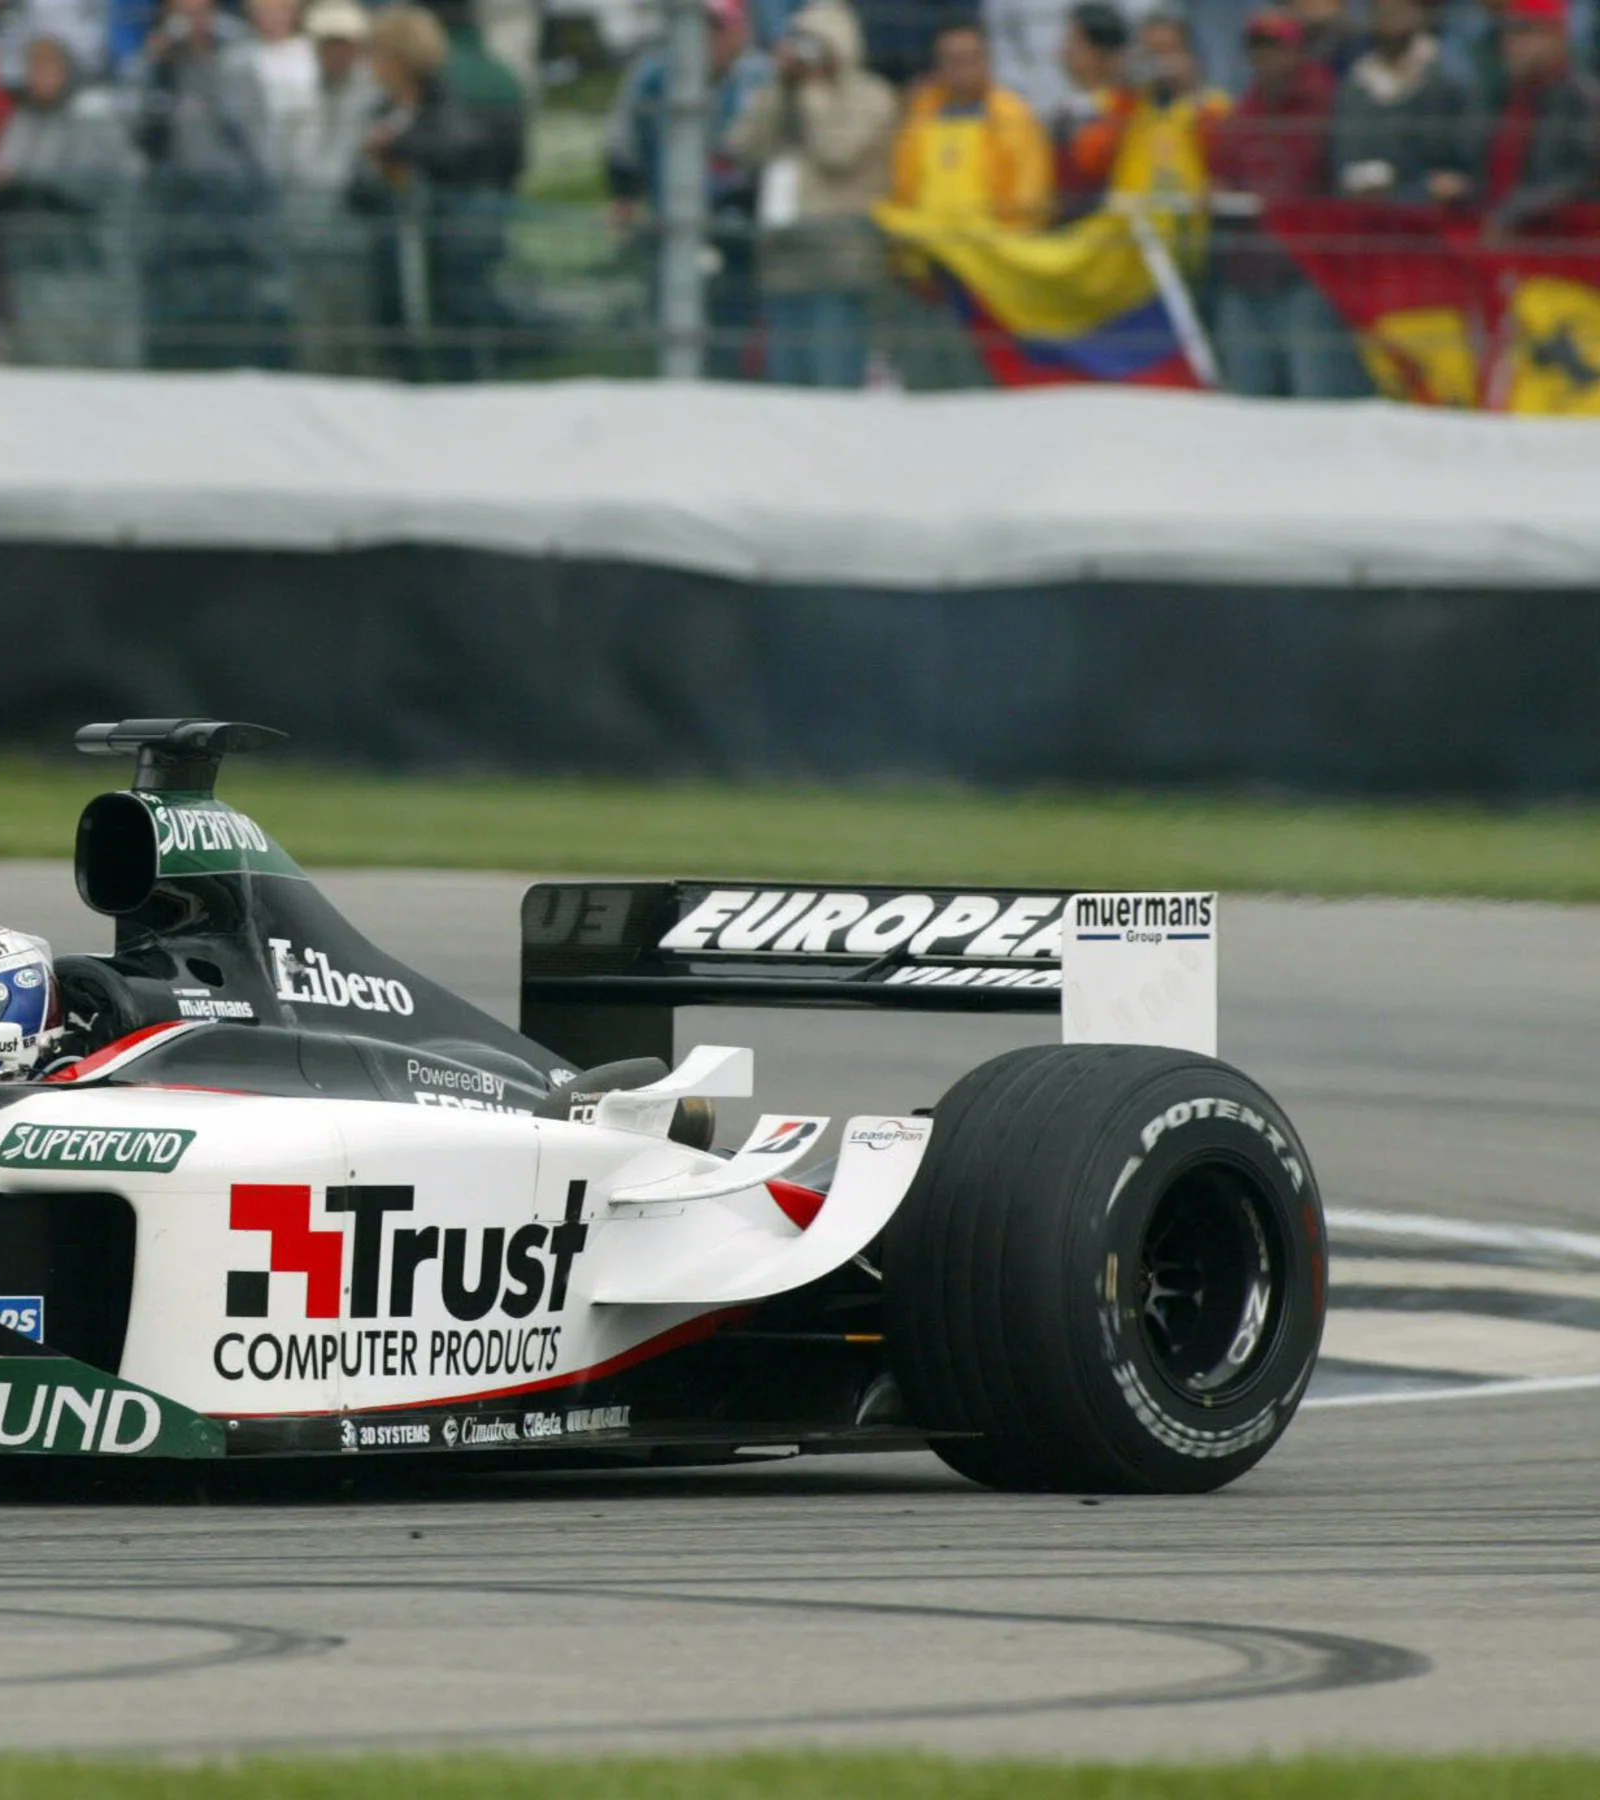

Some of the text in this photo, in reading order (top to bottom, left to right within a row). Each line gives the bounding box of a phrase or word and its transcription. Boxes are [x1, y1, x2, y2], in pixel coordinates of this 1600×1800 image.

[155, 806, 268, 855] SUPERFUND
[1076, 896, 1212, 927] muermans
[1126, 930, 1162, 945] Group
[268, 938, 414, 1017] Libero
[2, 1126, 183, 1164] SUPERFUND
[850, 1129, 924, 1142] LeasePlan
[325, 1180, 589, 1321] Trust
[213, 1326, 562, 1381] COMPUTER PRODUCTS
[360, 1424, 430, 1445] 3D SYSTEMS
